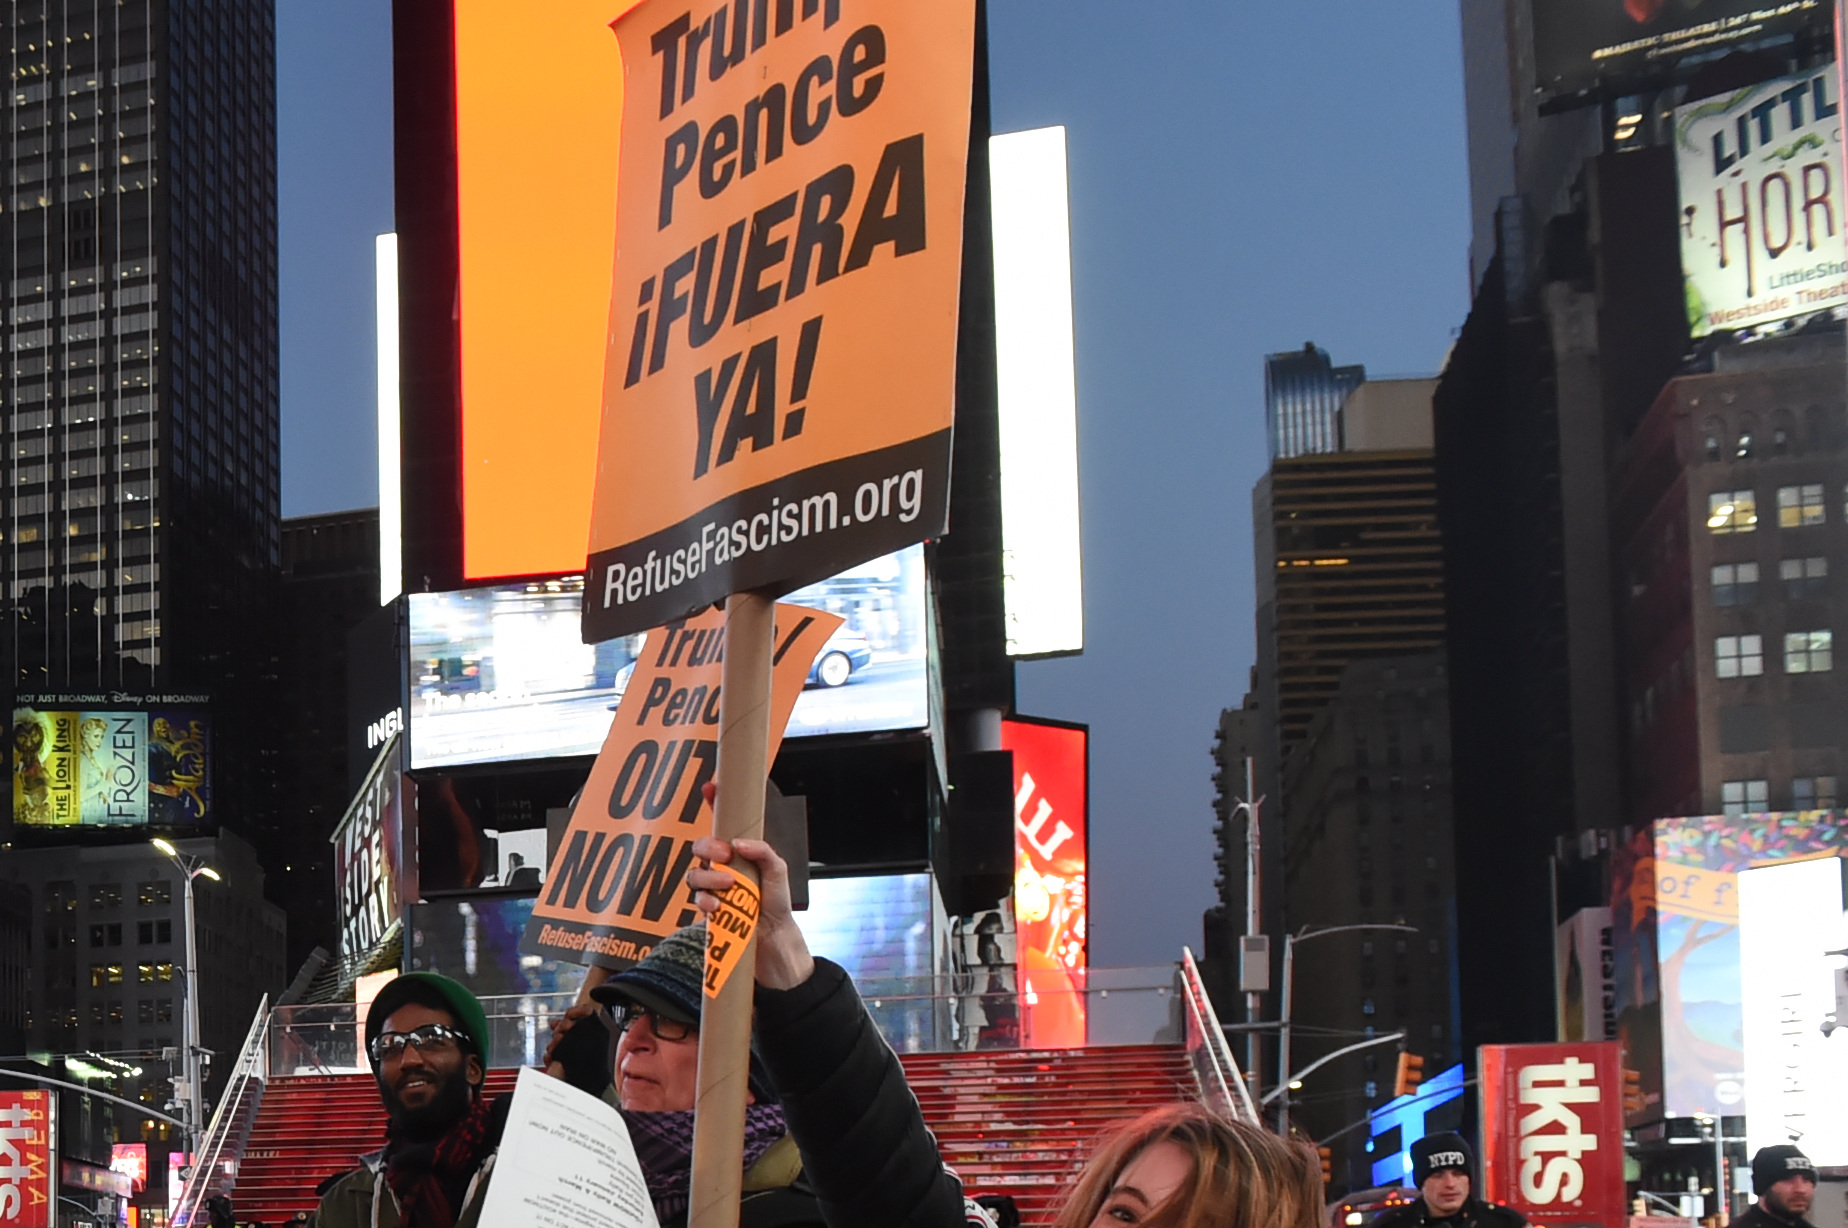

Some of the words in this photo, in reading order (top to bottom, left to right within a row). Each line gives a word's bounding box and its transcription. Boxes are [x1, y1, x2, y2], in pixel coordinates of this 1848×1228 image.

[656, 24, 887, 232] Pence
[622, 132, 927, 391] ¡FUERA
[692, 315, 824, 482] YA!
[603, 465, 925, 610] RefuseFascism.org
[52, 717, 71, 753] KING
[52, 757, 71, 790] LION
[107, 717, 142, 818] FROZEN
[55, 793, 70, 820] THE
[345, 830, 382, 917] SIDE
[537, 921, 652, 965] RefuseFascism.o
[706, 906, 751, 941] MUS
[1428, 1150, 1465, 1169] NYPD
[1519, 1056, 1601, 1206] tkts
